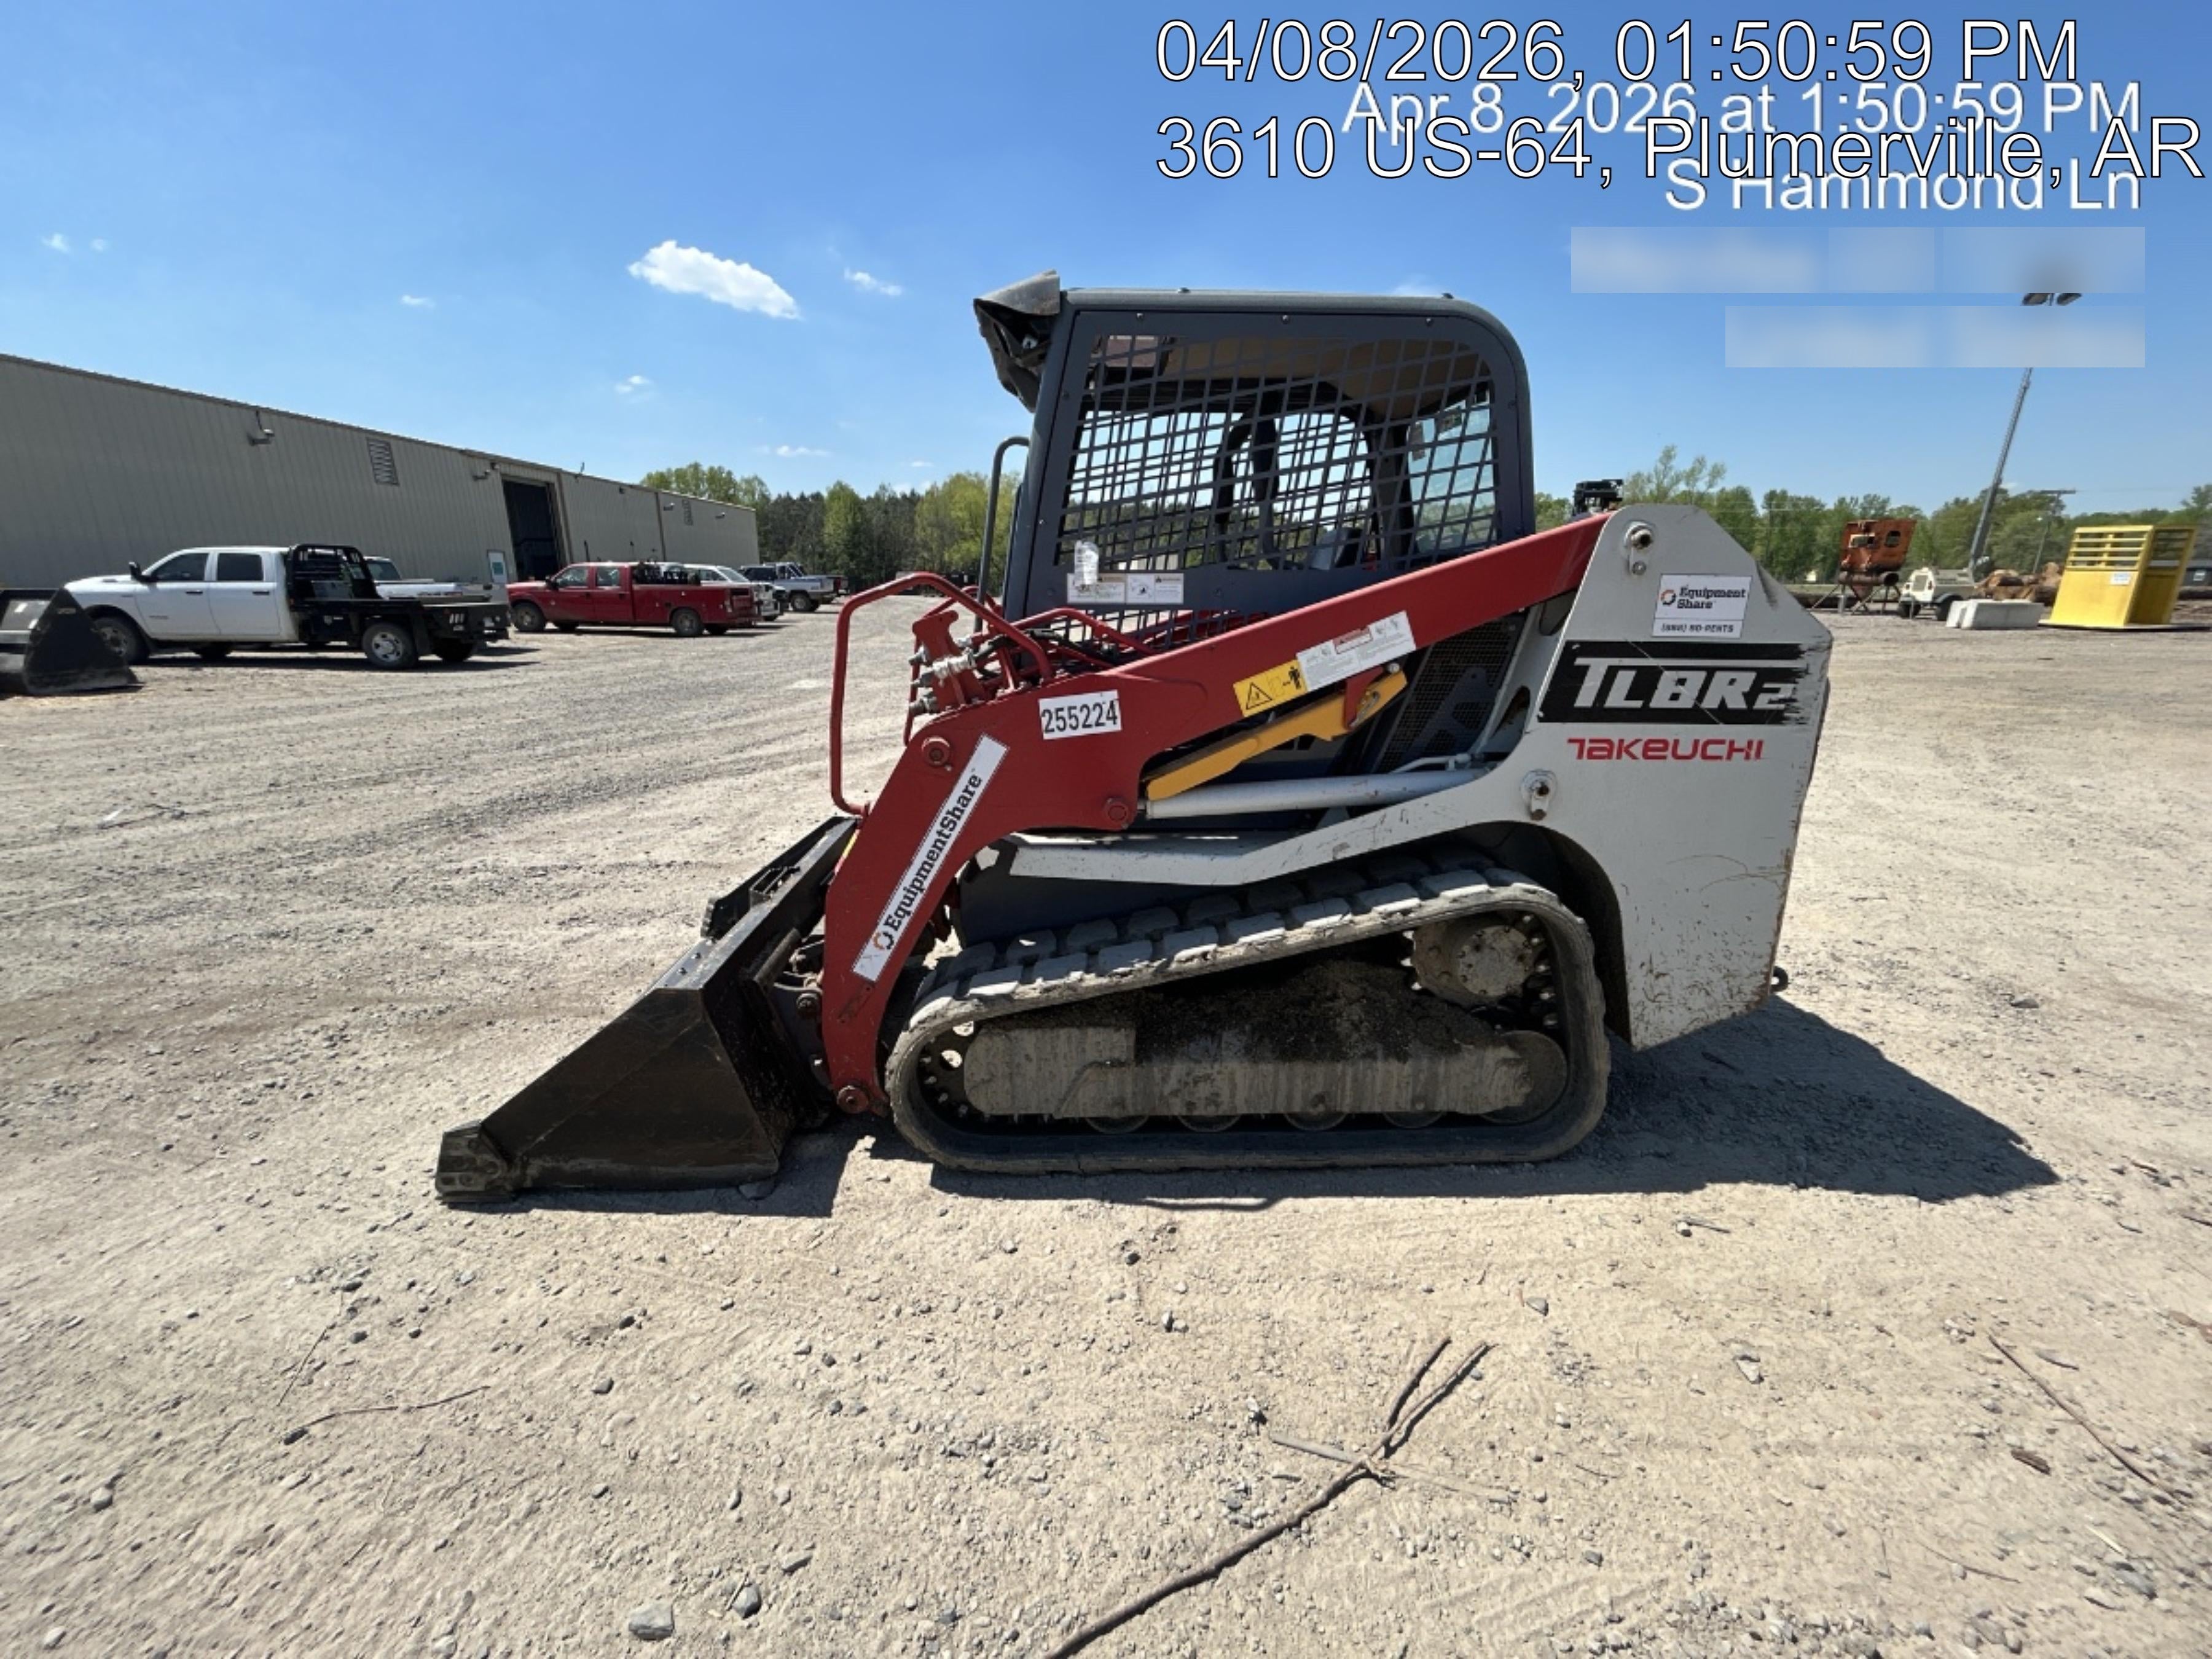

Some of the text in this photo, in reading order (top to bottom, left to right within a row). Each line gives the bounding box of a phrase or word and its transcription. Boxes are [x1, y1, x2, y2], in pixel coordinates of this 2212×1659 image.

[1677, 598, 1713, 609] Share
[1679, 585, 1746, 600] Equipment
[1041, 699, 1118, 734] 255224
[884, 772, 983, 933] EquipmentShare
